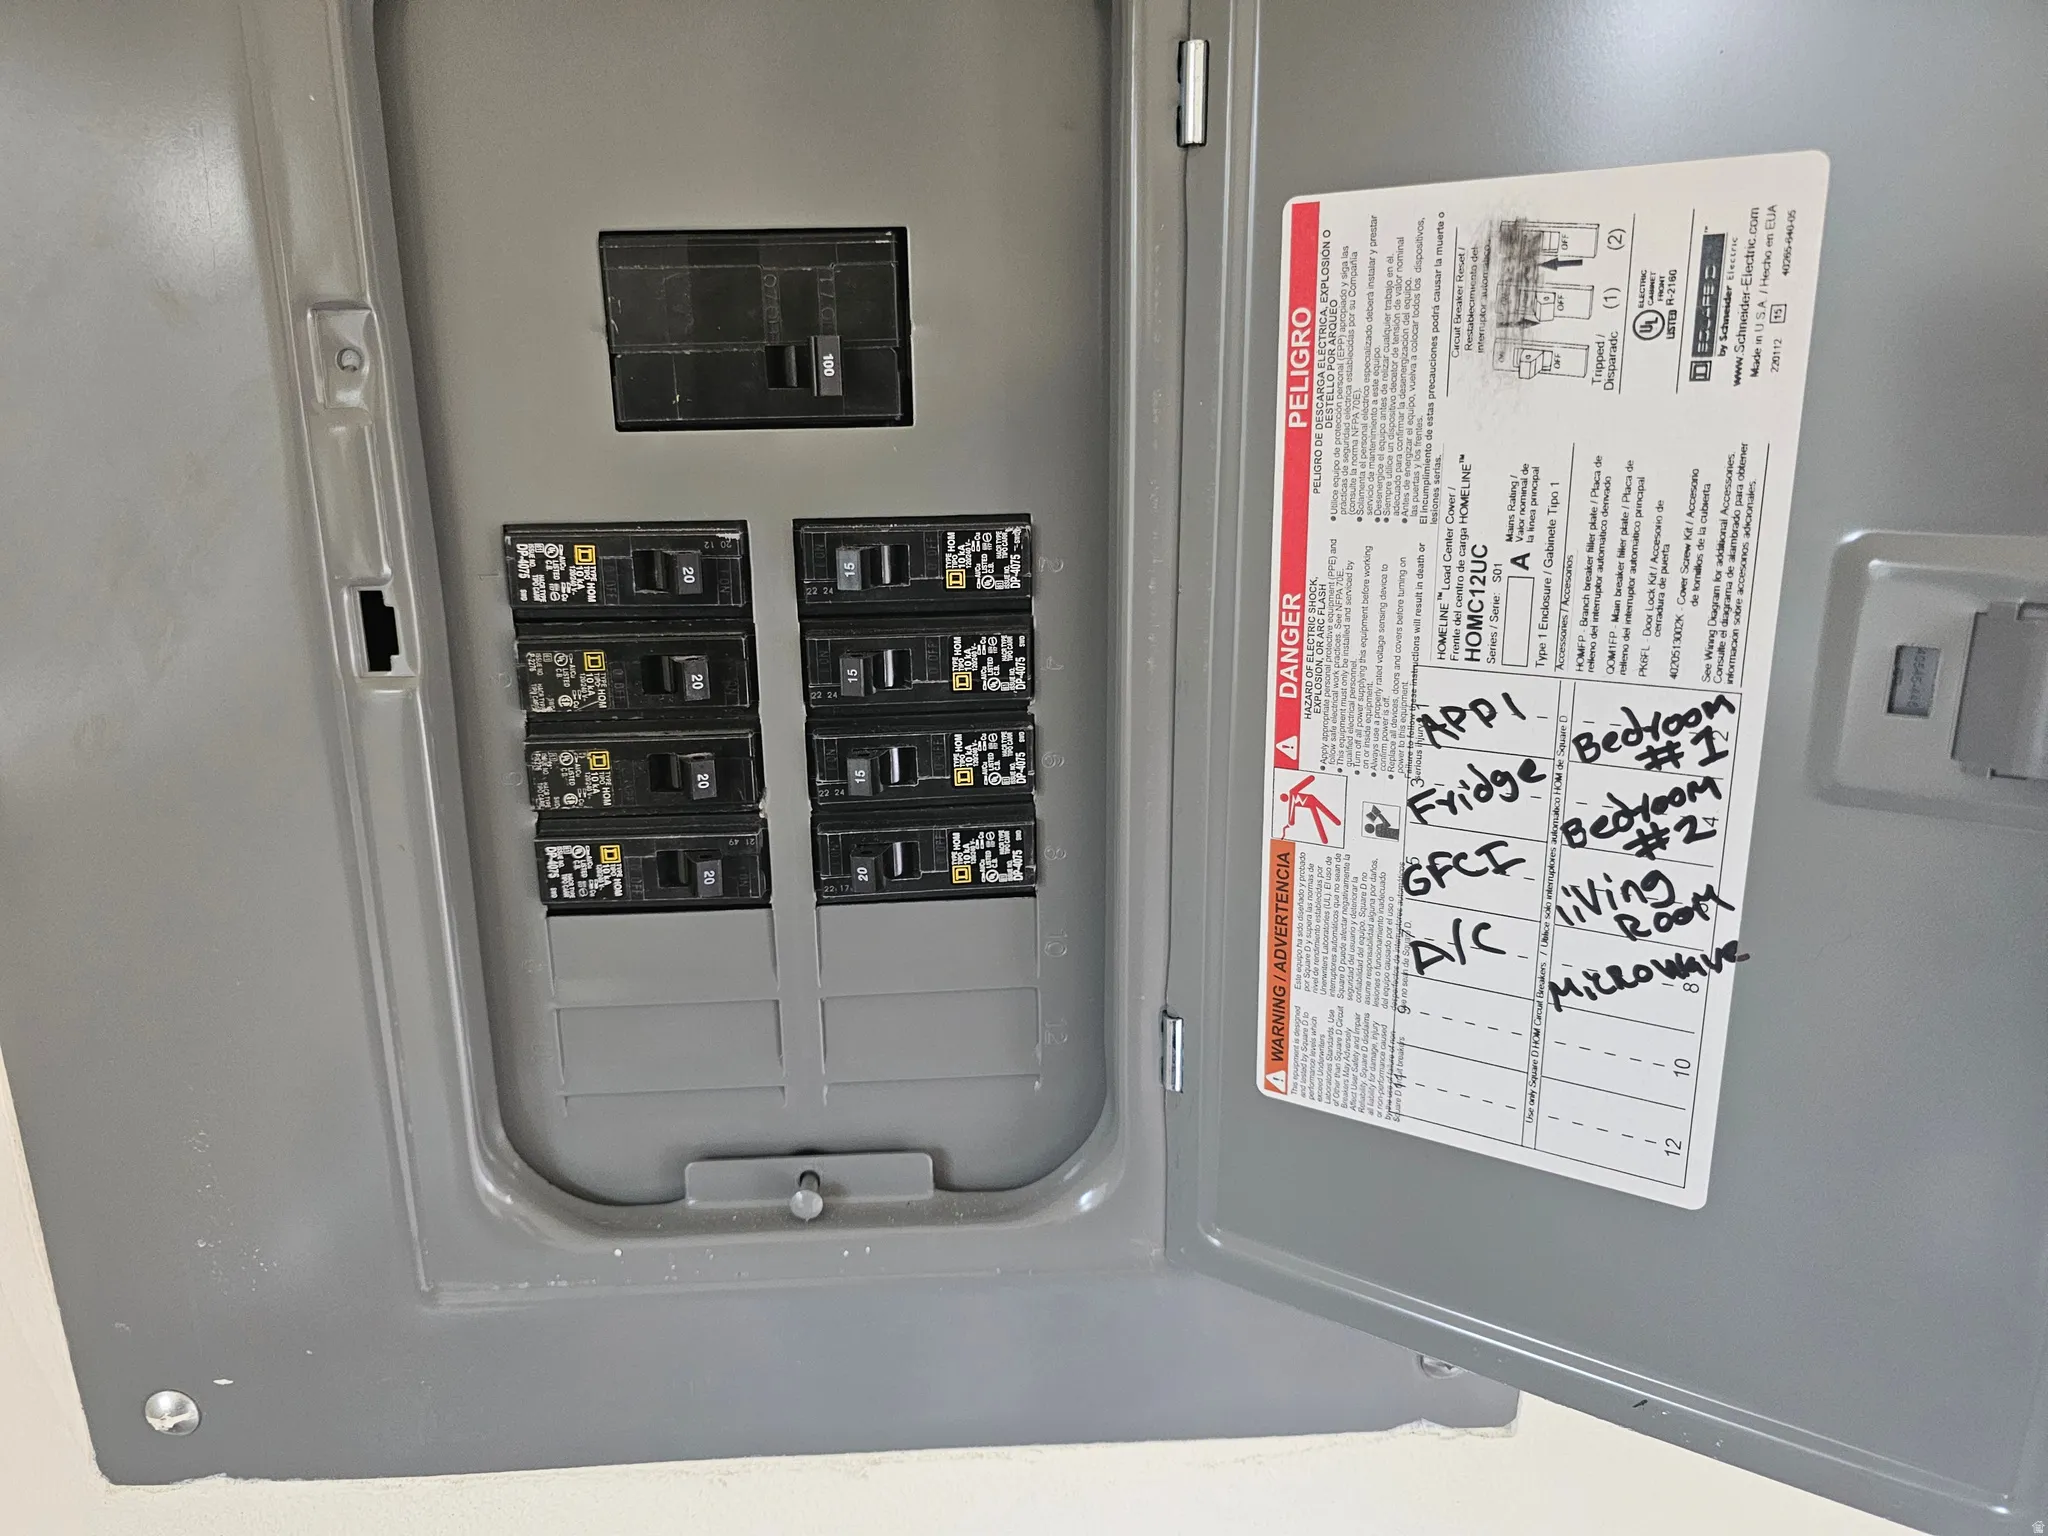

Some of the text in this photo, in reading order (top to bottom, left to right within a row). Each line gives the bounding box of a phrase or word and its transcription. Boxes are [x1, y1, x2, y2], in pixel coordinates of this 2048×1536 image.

[1765, 204, 1776, 230] EUA
[1322, 229, 1331, 238] O
[1606, 228, 1626, 250] (2)
[1766, 233, 1774, 247] en
[1455, 253, 1465, 282] Reset
[1759, 250, 1772, 286] Hecho
[1602, 287, 1621, 309] (1)
[1638, 269, 1647, 308] ELECTRIC
[1657, 275, 1665, 302] FRONT
[1665, 269, 1677, 306] R-2160
[1717, 238, 1738, 357] by Schneider Electric
[1733, 207, 1758, 386] www.Schneider-Electric.com
[1453, 285, 1463, 324] Breaker
[1666, 309, 1677, 339] LISTED
[1451, 326, 1461, 358] Circuit
[1755, 335, 1763, 345] in
[822, 353, 834, 377] 100
[1288, 307, 1311, 427] PELIGRO
[1324, 299, 1338, 428] DESTELLO POR ARQUEO
[1591, 341, 1605, 384] Tripped
[1750, 348, 1761, 377] Made
[1770, 338, 1782, 372] 220112
[1315, 371, 1325, 430] DESCARGA
[1314, 432, 1323, 447] DE
[1312, 449, 1322, 494] PELIGRO
[1444, 493, 1455, 524] Cover
[1507, 480, 1519, 511] Rating
[1515, 463, 1529, 542] Valor nominal de
[1546, 491, 1560, 515] Tipo
[1505, 514, 1515, 542] Mains
[947, 532, 955, 552] HOM
[1442, 528, 1453, 562] Center
[1458, 527, 1469, 557] carga
[1543, 519, 1556, 568] Gabinete
[516, 543, 530, 579] DP-4075
[844, 562, 856, 578] 15
[958, 557, 966, 568] 10
[1009, 554, 1021, 589] DP-4075
[1456, 559, 1465, 573] de
[1491, 563, 1502, 583] S01
[1510, 552, 1530, 571] A
[682, 566, 696, 584] 20
[1441, 565, 1451, 590] Load
[1561, 554, 1573, 606] Accesorios
[586, 582, 596, 602] HOM
[806, 586, 834, 595] 22 24
[1455, 575, 1464, 608] centro
[1464, 544, 1487, 662] HOMC12UC
[1538, 577, 1552, 630] Enclosure
[1452, 610, 1462, 626] del
[953, 636, 962, 656] HOM
[1279, 593, 1300, 698] DANGER
[1304, 576, 1318, 719] HAZARD OF ELECTRIC SHOCK,
[1313, 583, 1326, 714] EXPLOSION, OR ARC FLASH
[1449, 628, 1460, 661] Frente
[1486, 631, 1497, 664] Series
[1534, 642, 1548, 667] Type
[1556, 614, 1568, 670] Accessories
[847, 668, 858, 683] 15
[964, 660, 972, 671] 10
[1015, 656, 1026, 690] DP-4075
[691, 674, 704, 691] 20
[810, 690, 838, 699] 22 24
[598, 689, 607, 708] HOM
[954, 734, 963, 753] HOM
[965, 756, 972, 766] 10
[1016, 752, 1027, 784] DP-4075
[696, 773, 710, 789] 20
[855, 769, 866, 784] 15
[1410, 776, 1424, 787] 3
[602, 786, 612, 807] HOM
[818, 788, 845, 797] 22 24
[1406, 758, 1547, 825] Fridge
[1701, 815, 1718, 827] 4
[952, 832, 960, 850] HOM
[703, 870, 716, 885] 20
[858, 866, 869, 882] 20
[1013, 849, 1023, 881] DP-4075
[1403, 839, 1526, 896] GFCI
[1271, 852, 1290, 1061] WARNING / ADVERTENCIA
[1683, 981, 1700, 994] 8
[1674, 1057, 1691, 1079] 10
[1665, 1136, 1682, 1159] 12
